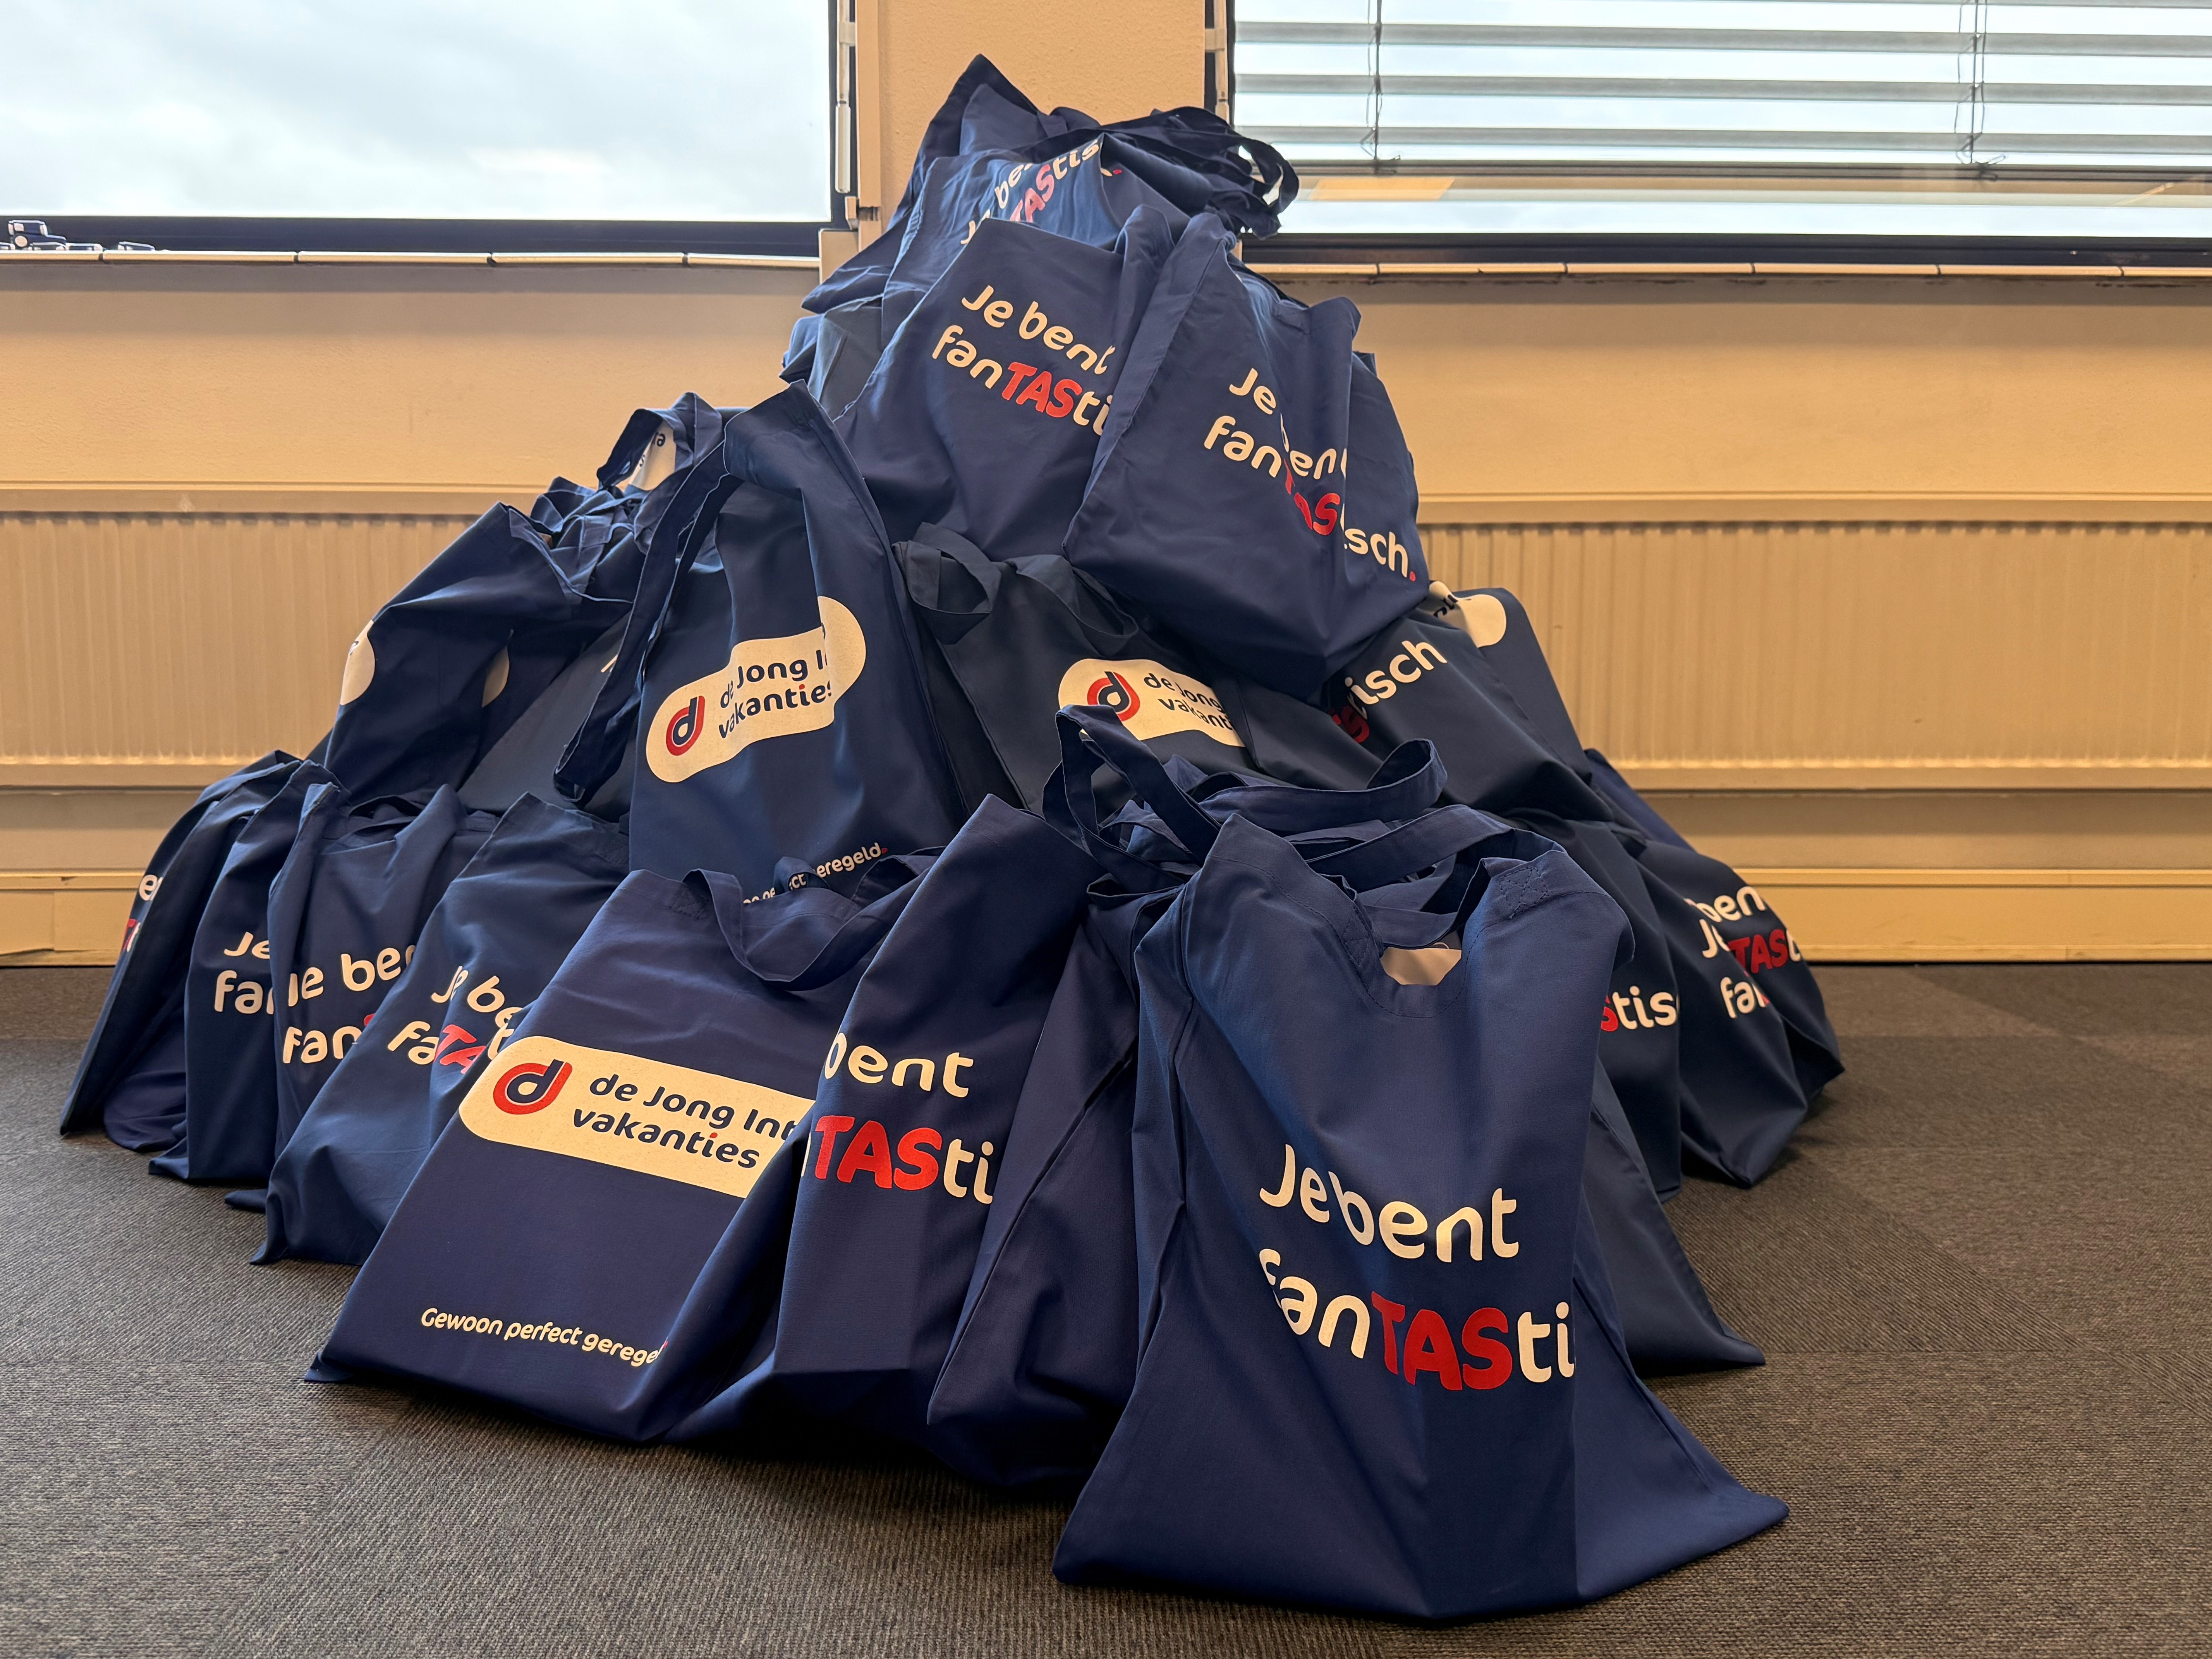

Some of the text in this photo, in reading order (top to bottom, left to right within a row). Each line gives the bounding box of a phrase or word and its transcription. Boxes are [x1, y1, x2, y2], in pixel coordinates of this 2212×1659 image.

[962, 285, 1013, 328] Je
[1229, 368, 1276, 415] Je
[737, 659, 808, 689] Jong
[1144, 673, 1175, 690] de
[589, 1074, 637, 1101] de
[643, 1086, 734, 1129] Jong
[573, 1109, 760, 1168] vakanties
[1259, 1144, 1519, 1263] Je bent
[421, 1308, 503, 1335] Gewoon
[504, 1322, 583, 1345] perfect
